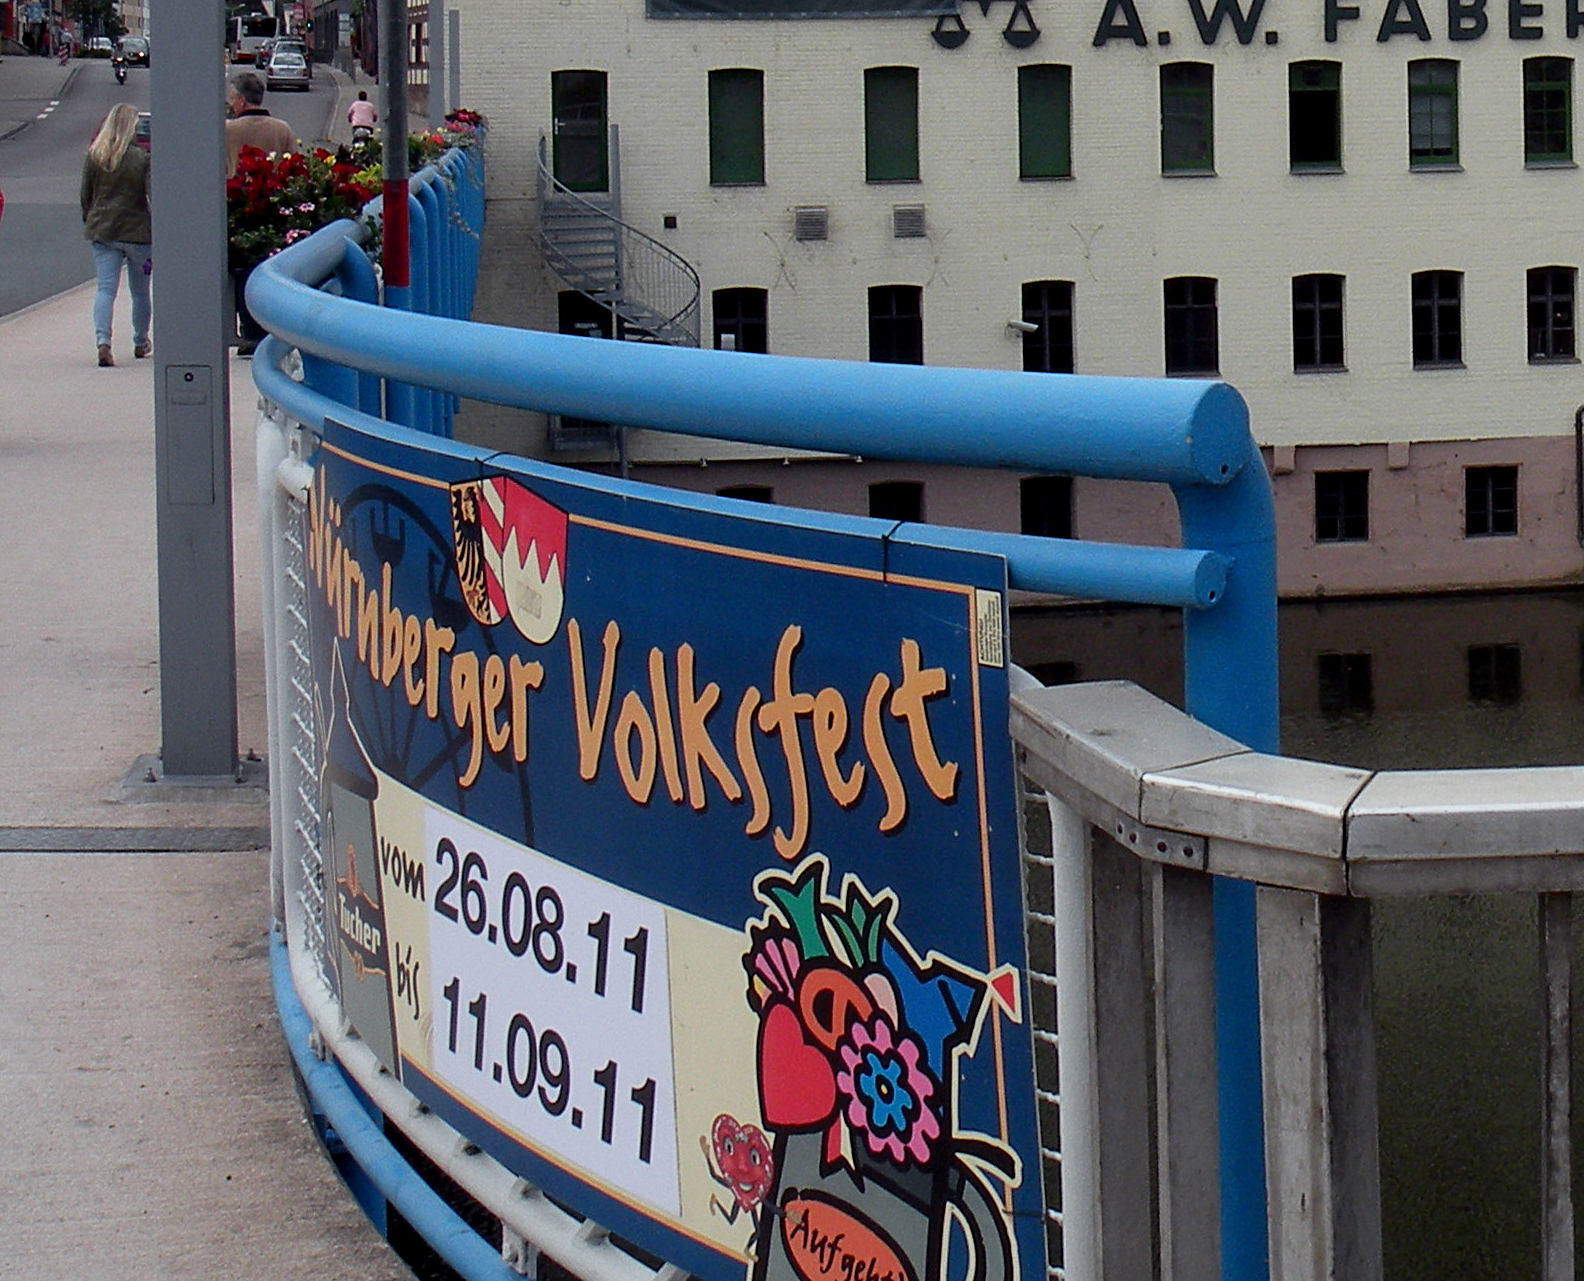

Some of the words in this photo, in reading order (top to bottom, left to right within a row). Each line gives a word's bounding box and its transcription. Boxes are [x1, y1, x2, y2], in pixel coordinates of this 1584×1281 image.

[309, 464, 544, 788] Nürnberger
[568, 617, 959, 860] Volksfest
[338, 891, 381, 956] Tucher
[380, 836, 425, 903] vom
[434, 837, 649, 1014] 26.08.11
[395, 941, 419, 1021] bis
[443, 976, 657, 1164] 11.09.11
[790, 1208, 844, 1274] Auf
